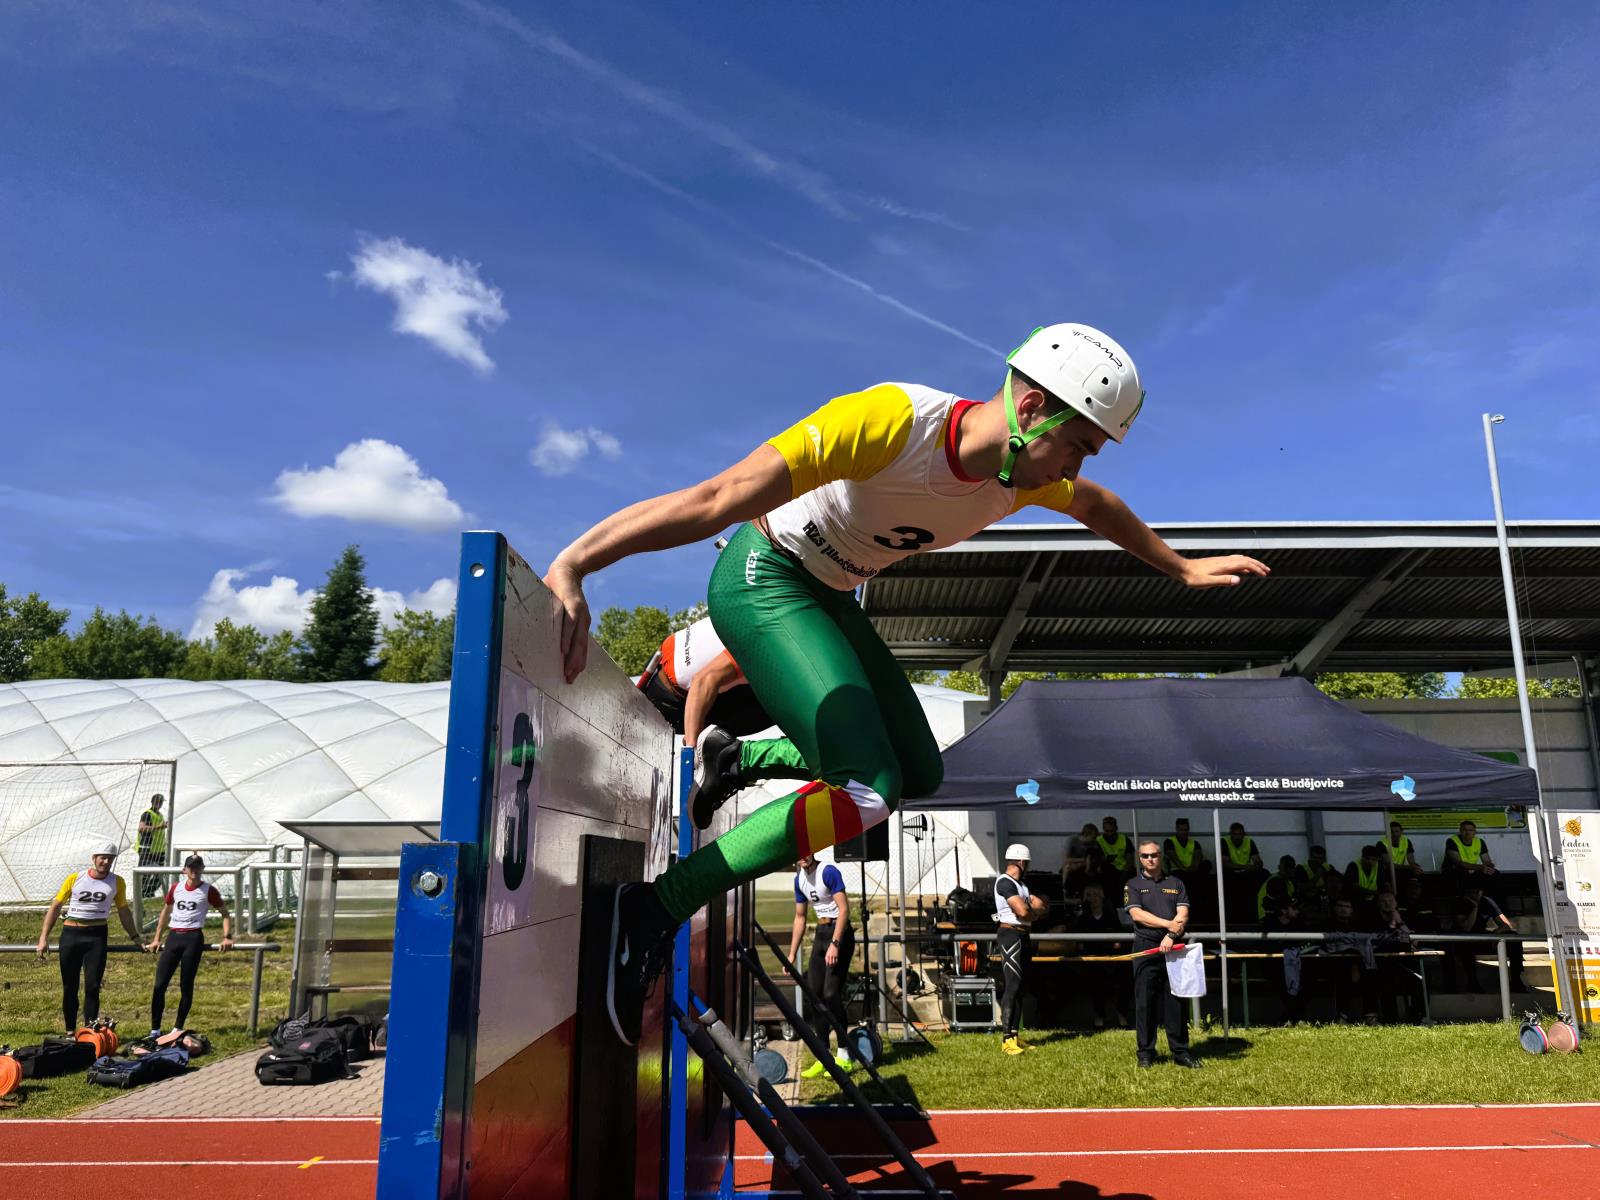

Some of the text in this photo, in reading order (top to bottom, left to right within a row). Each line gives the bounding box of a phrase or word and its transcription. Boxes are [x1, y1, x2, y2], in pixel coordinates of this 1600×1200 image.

[1083, 335, 1123, 369] CAMP
[802, 520, 826, 547] HZS
[873, 526, 935, 550] 3
[1087, 776, 1345, 791] Střední škola polytechnická České Budějovice
[503, 712, 535, 891] 3
[1179, 791, 1256, 803] www.sspcb.cz
[79, 891, 107, 902] 29
[809, 890, 820, 902] 5
[177, 900, 198, 911] 63
